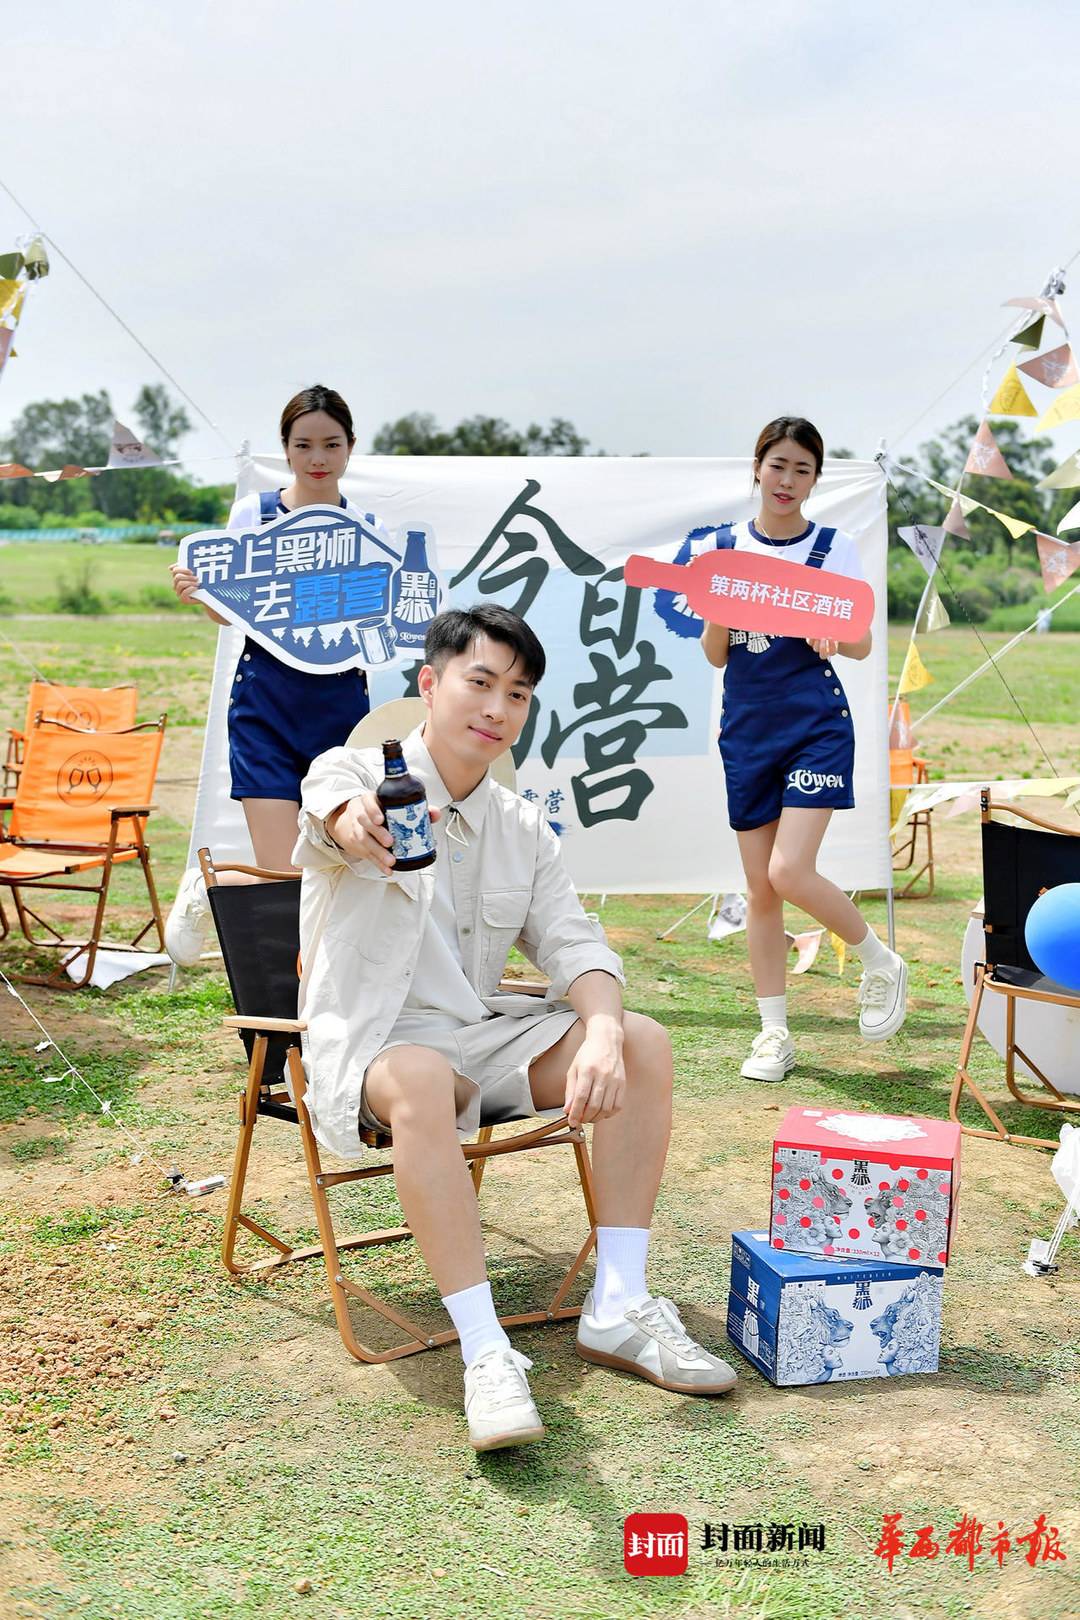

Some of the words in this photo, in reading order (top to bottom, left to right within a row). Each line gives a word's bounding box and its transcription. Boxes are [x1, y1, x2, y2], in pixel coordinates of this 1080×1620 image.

[193, 527, 356, 584] 带上黑狮
[254, 568, 388, 623] 去露营
[393, 570, 436, 624] 黑狮
[709, 574, 855, 621] 策两杯社区酒馆
[787, 769, 844, 794] Löwen
